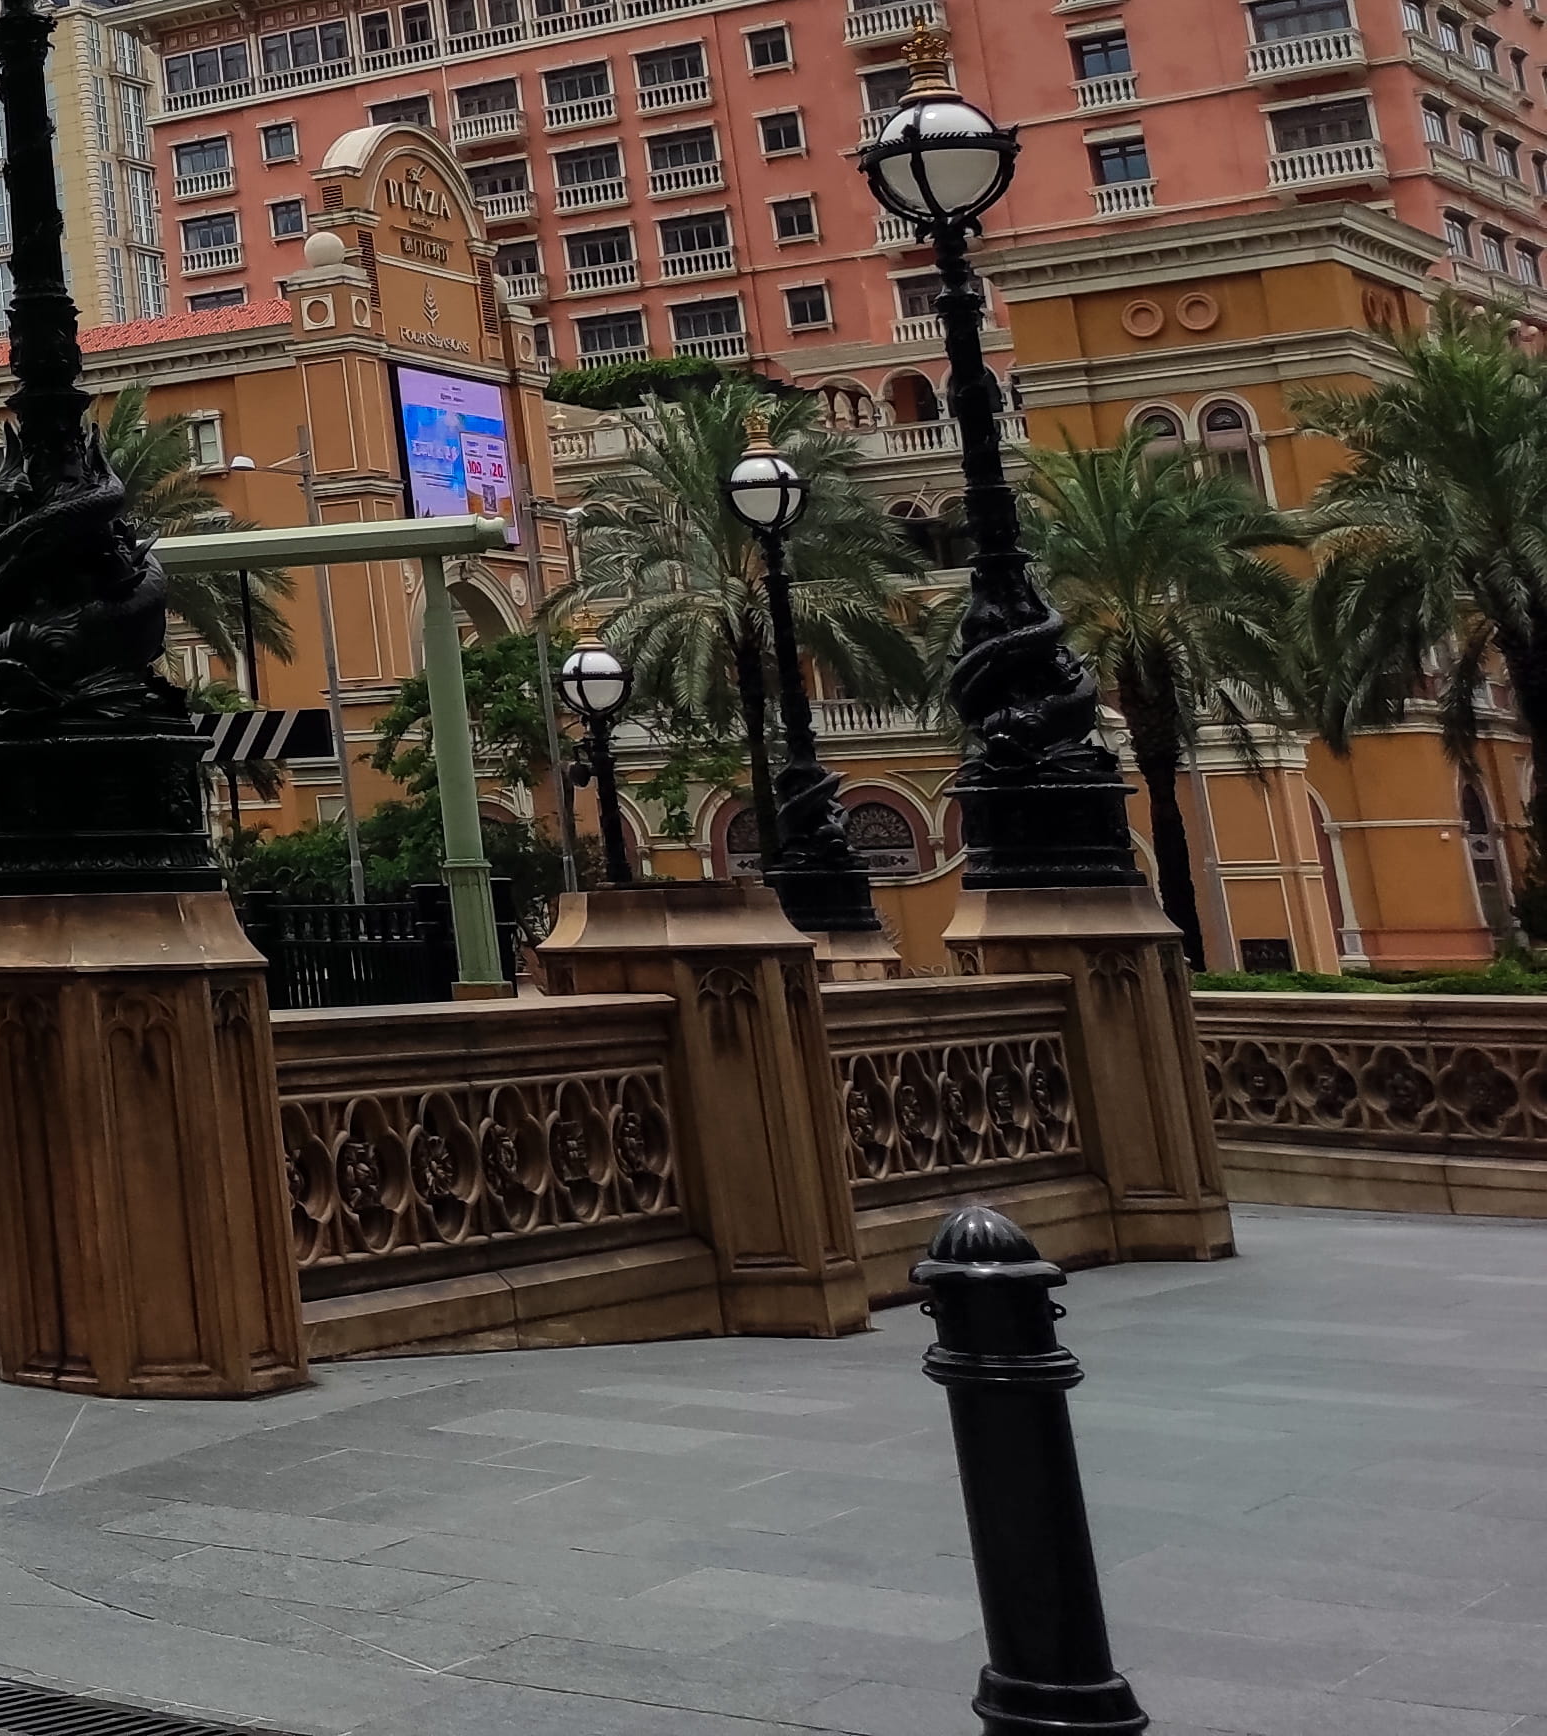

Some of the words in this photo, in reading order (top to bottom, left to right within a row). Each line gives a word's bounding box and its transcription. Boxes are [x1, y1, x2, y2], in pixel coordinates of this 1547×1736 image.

[388, 177, 452, 220] PLAZA
[398, 324, 426, 345] FOUR
[426, 330, 472, 354] SEASONS
